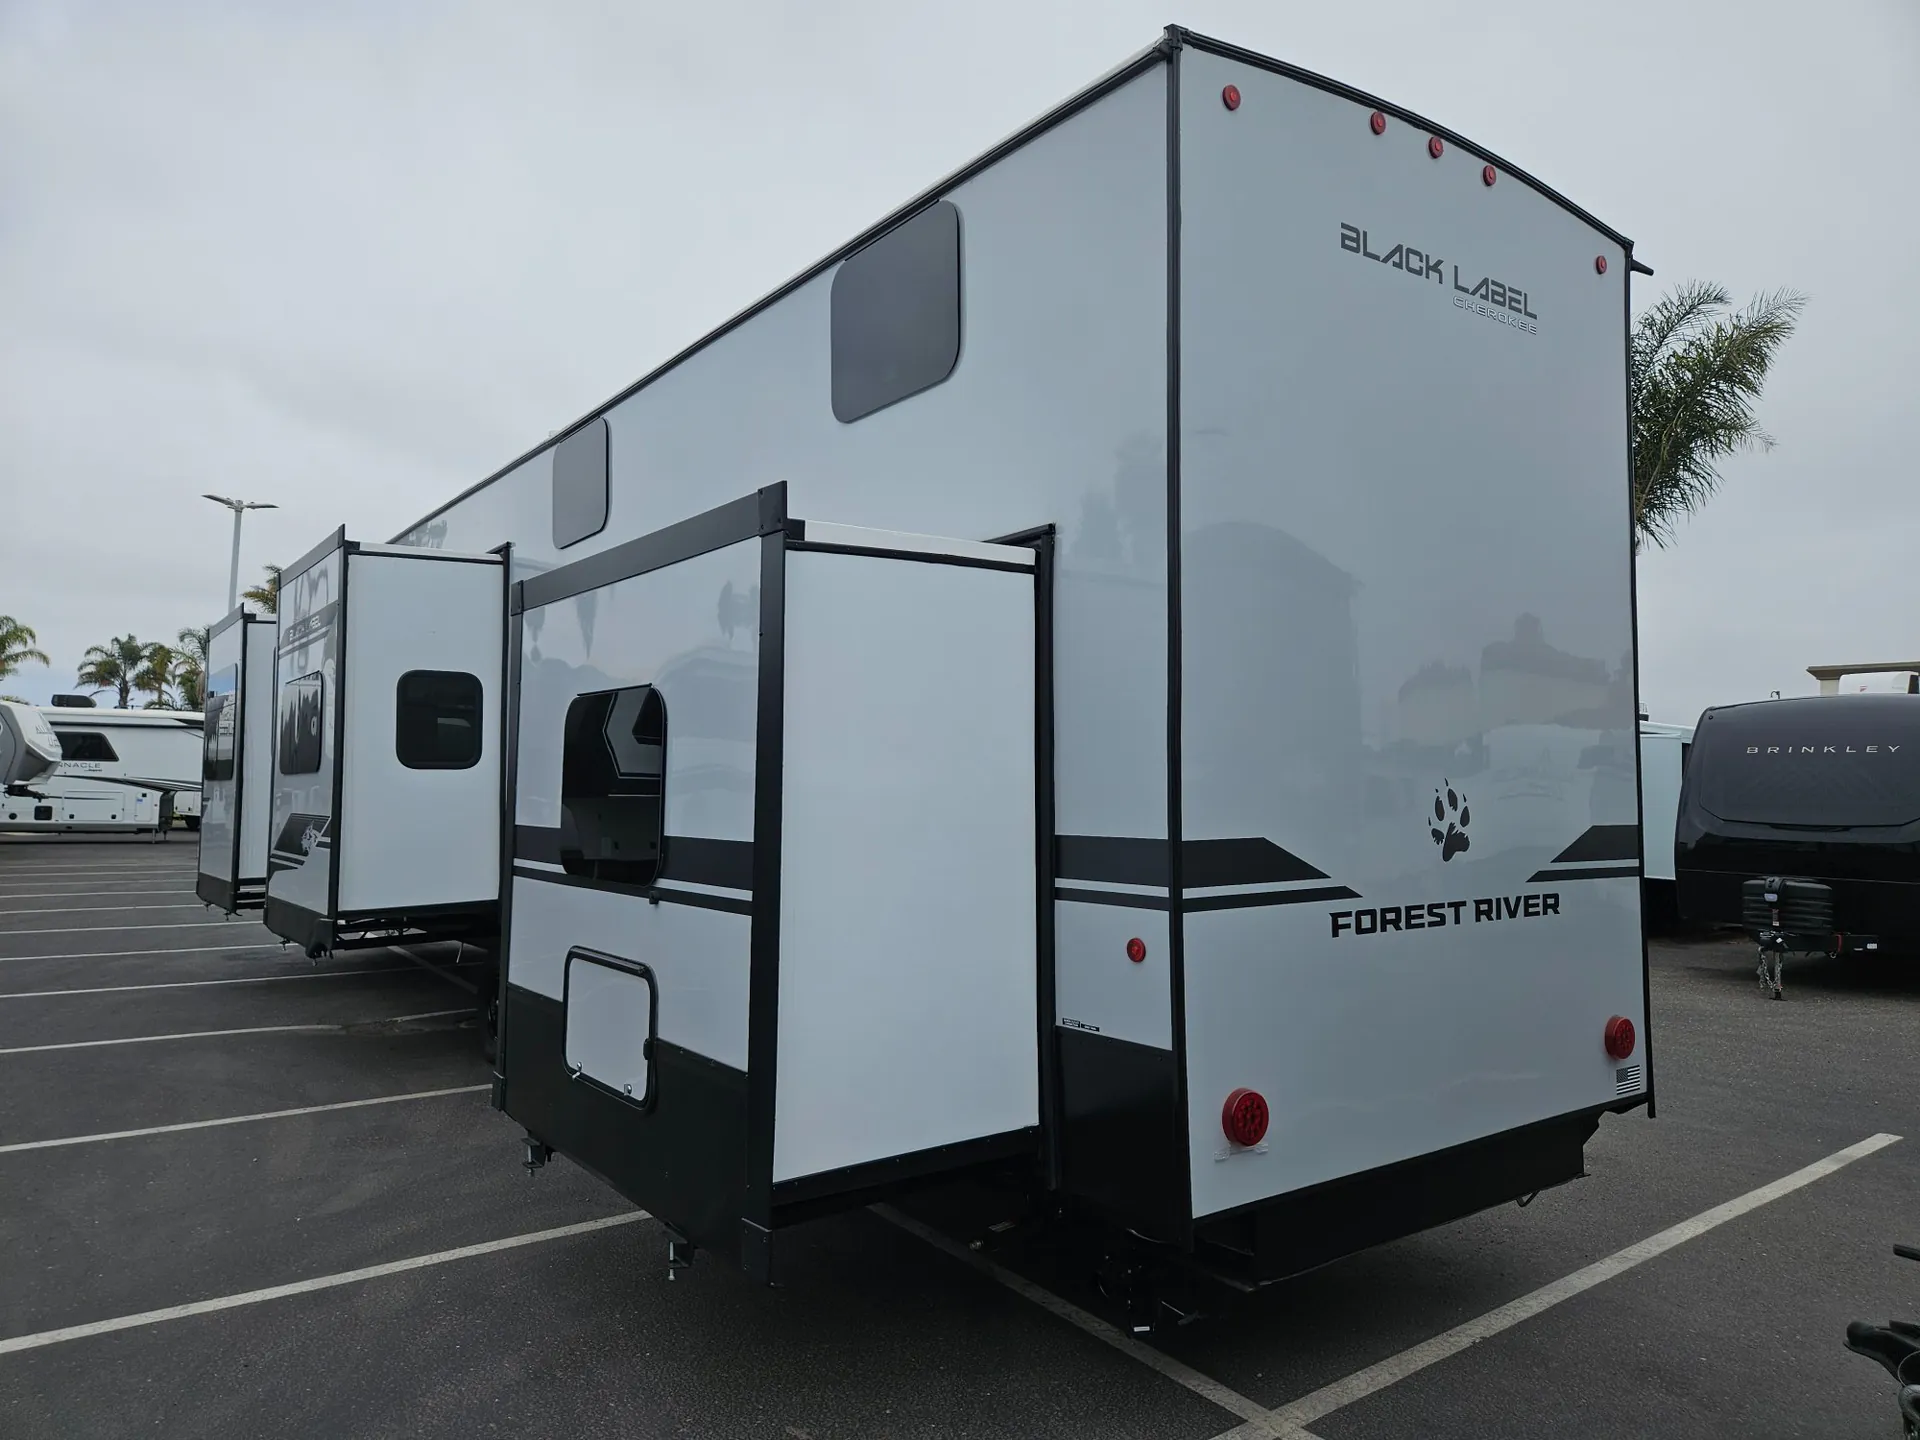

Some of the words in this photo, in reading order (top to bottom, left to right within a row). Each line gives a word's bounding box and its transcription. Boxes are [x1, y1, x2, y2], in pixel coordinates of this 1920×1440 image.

[1340, 222, 1444, 284] BLACK
[1454, 265, 1538, 320] LABEL
[1453, 296, 1537, 335] CHEROKEE
[1746, 745, 1900, 754] BRINKLEY
[1329, 901, 1467, 938] FOREST
[1473, 893, 1561, 922] RIVER
